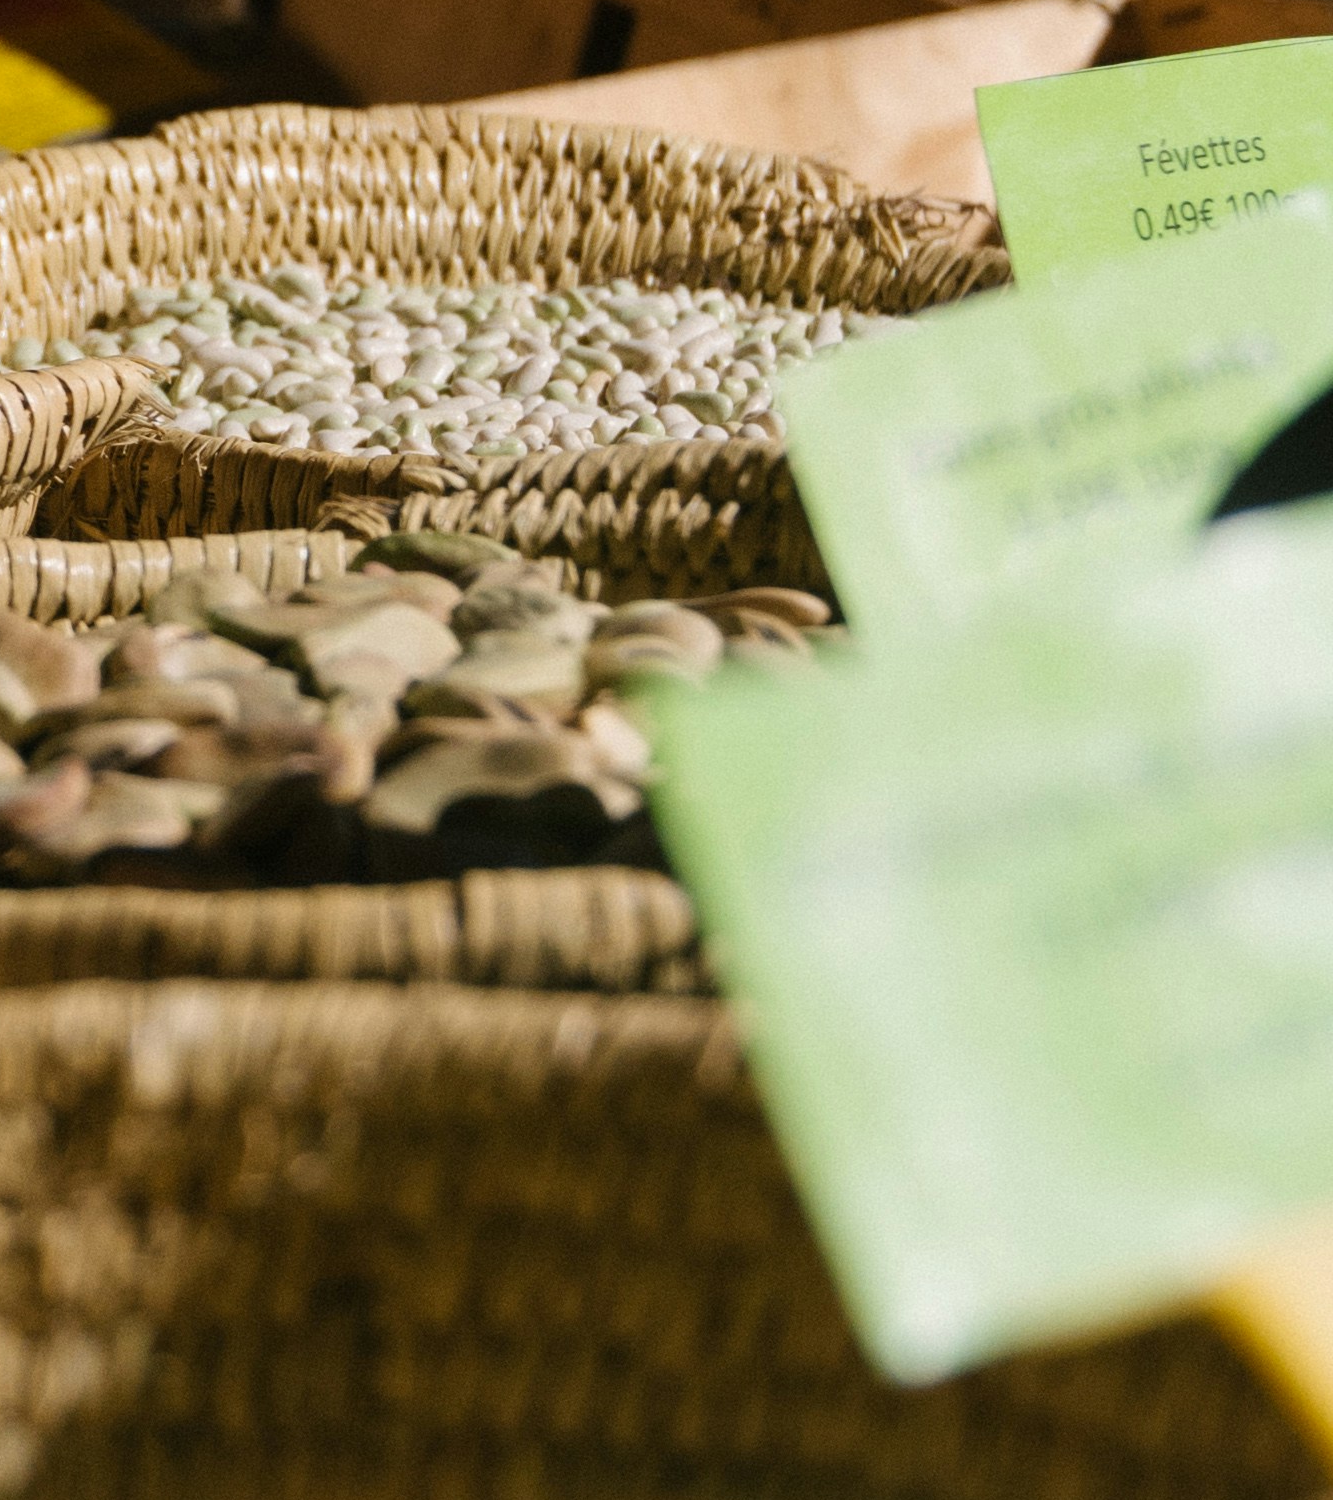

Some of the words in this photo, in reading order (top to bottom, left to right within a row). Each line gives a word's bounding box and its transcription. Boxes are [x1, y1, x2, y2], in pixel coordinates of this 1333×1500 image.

[1139, 133, 1267, 178] Févettes
[1134, 198, 1219, 241] 0.49€
[1226, 188, 1299, 224] 100
